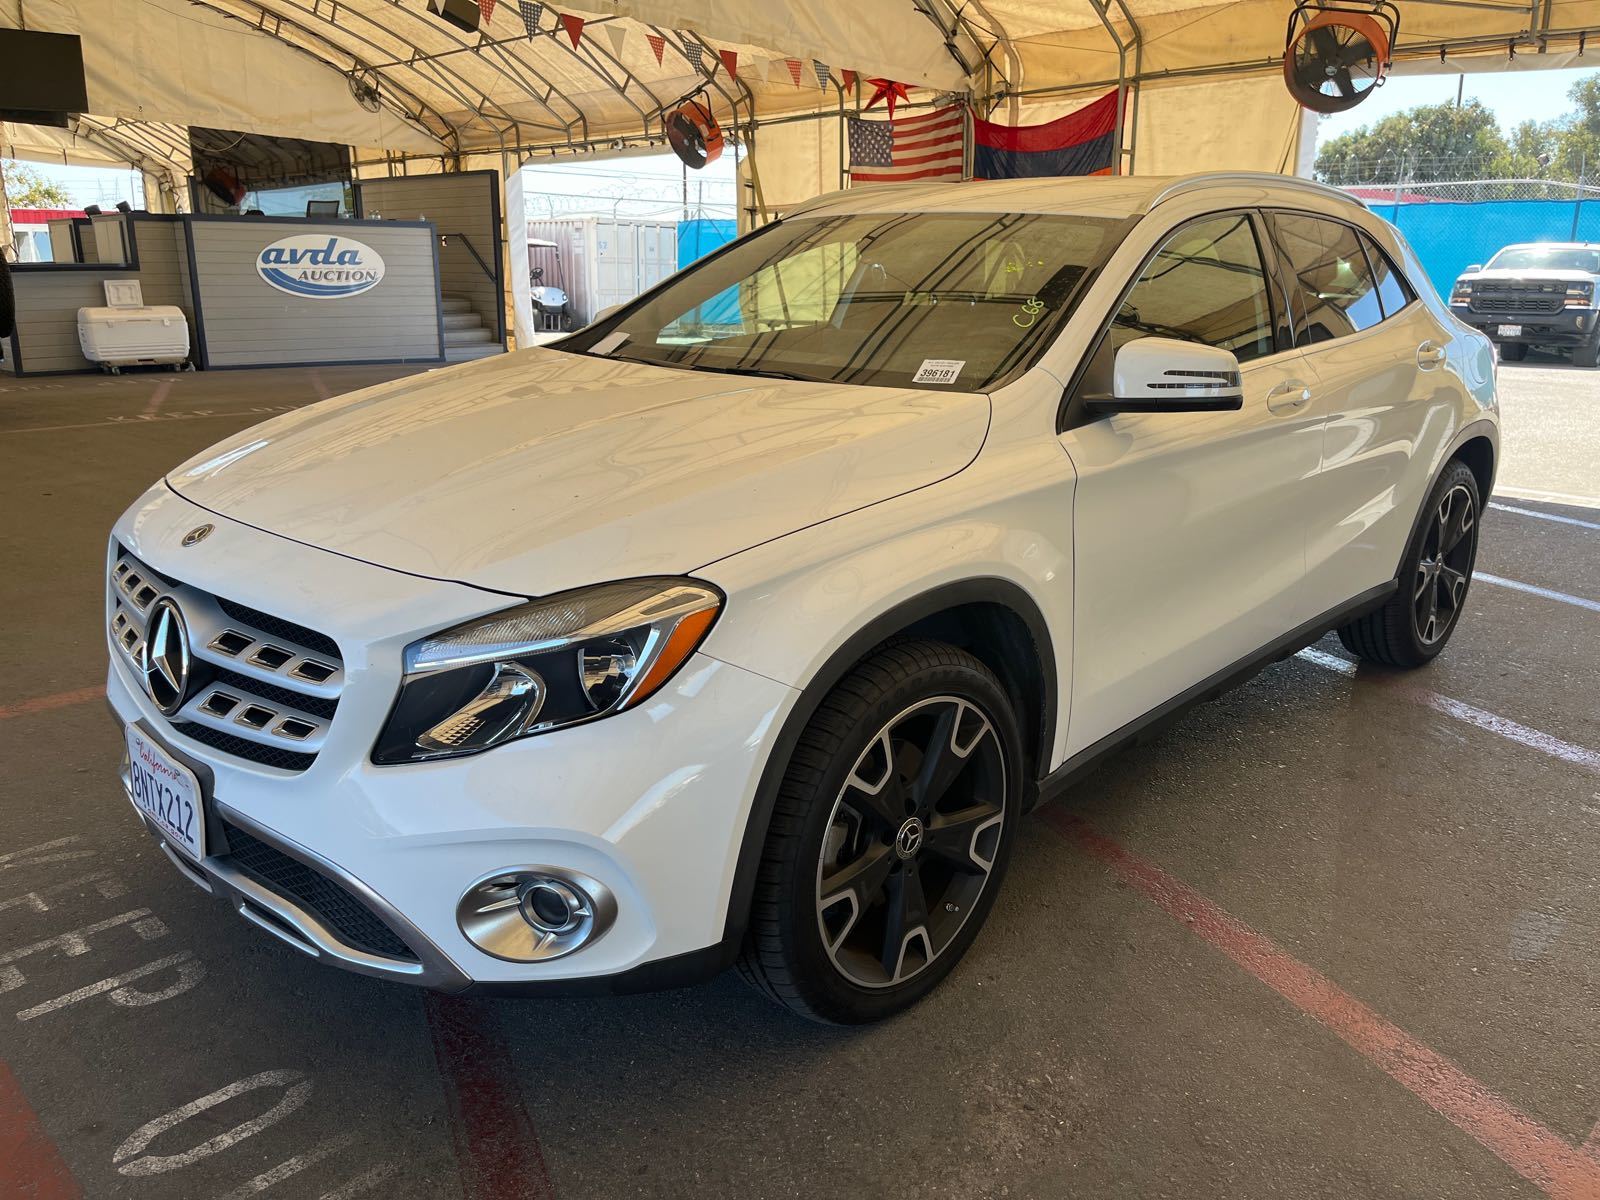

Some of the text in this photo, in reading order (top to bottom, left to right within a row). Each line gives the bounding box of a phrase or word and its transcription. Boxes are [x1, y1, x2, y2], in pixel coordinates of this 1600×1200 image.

[261, 238, 363, 266] avda
[298, 270, 377, 282] AUCTION
[920, 368, 956, 378] 396181
[132, 760, 195, 845] 8NTX212
